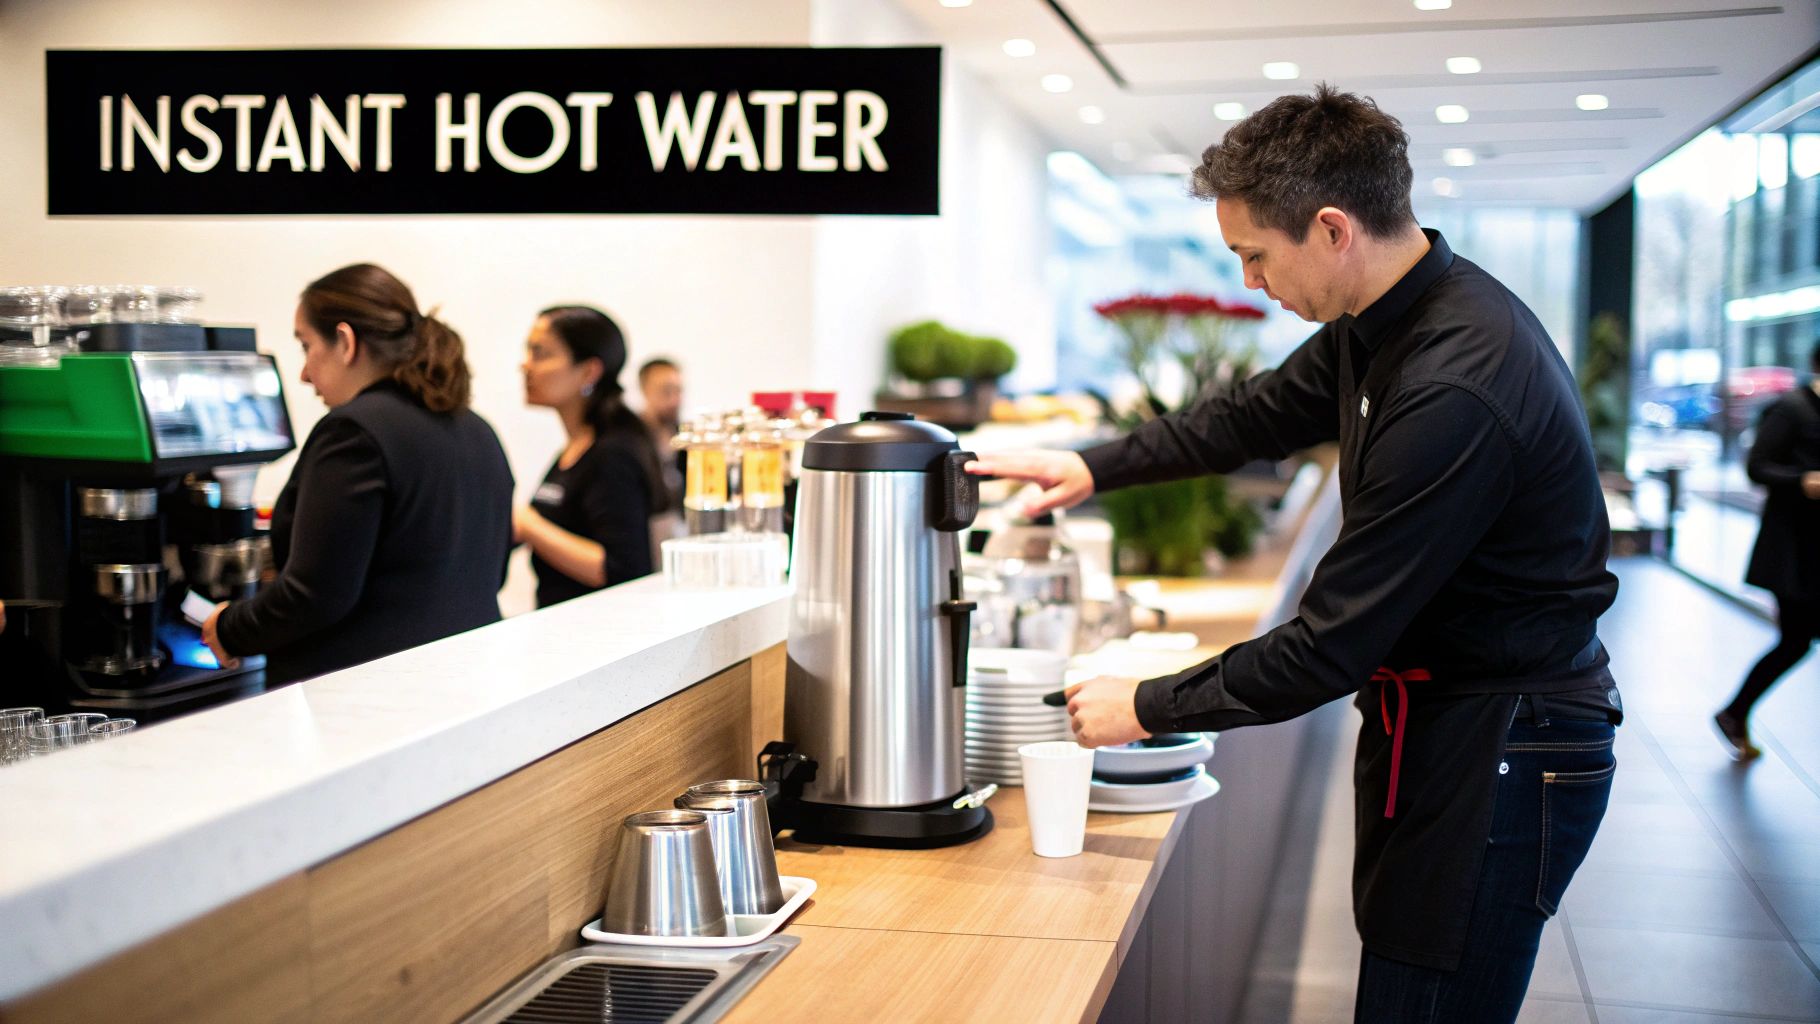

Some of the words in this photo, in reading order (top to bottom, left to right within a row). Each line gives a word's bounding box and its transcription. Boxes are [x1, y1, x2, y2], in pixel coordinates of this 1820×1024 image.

[99, 93, 407, 173] INSTANT
[435, 91, 614, 174] HOT
[635, 90, 889, 173] WATER
